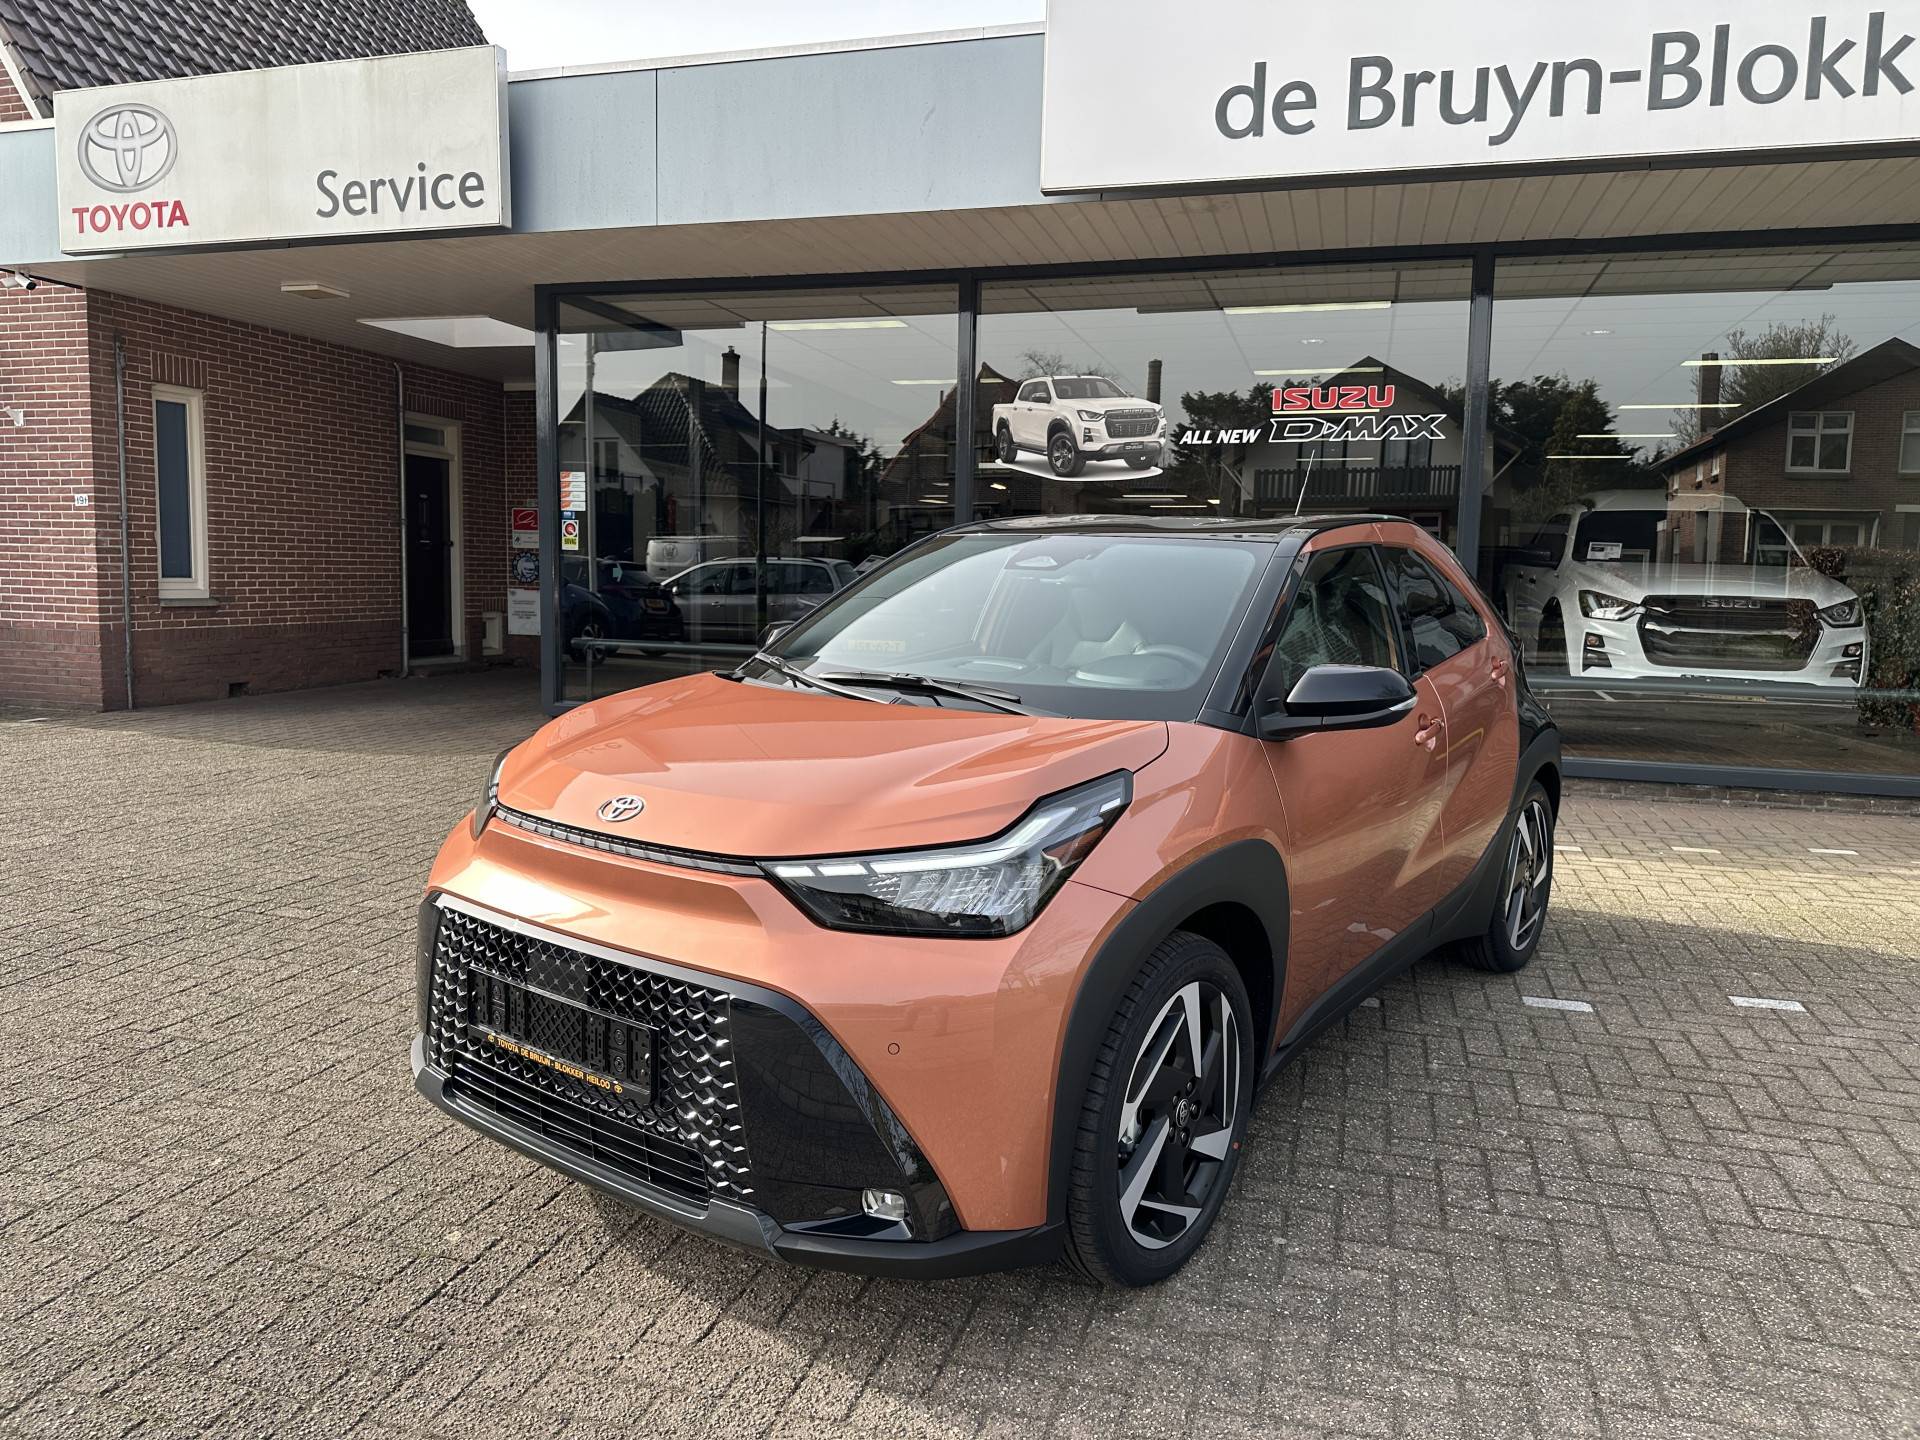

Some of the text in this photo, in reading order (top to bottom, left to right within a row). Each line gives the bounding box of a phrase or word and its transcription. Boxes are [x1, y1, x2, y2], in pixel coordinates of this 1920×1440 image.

[1214, 11, 1916, 147] de Bruyn-Blokk
[316, 161, 485, 218] Service
[72, 200, 190, 234] TOYOTA
[1272, 385, 1396, 411] ISUZU
[1179, 430, 1212, 445] ALL
[1215, 429, 1262, 445] NEW
[1701, 599, 1761, 609] ISUZU
[497, 1038, 519, 1052] TOYOTA
[520, 1048, 529, 1056] DE
[529, 1051, 551, 1067] BRUIJN
[554, 1062, 584, 1080] BLOKKER
[586, 1073, 611, 1090] HEILOO
